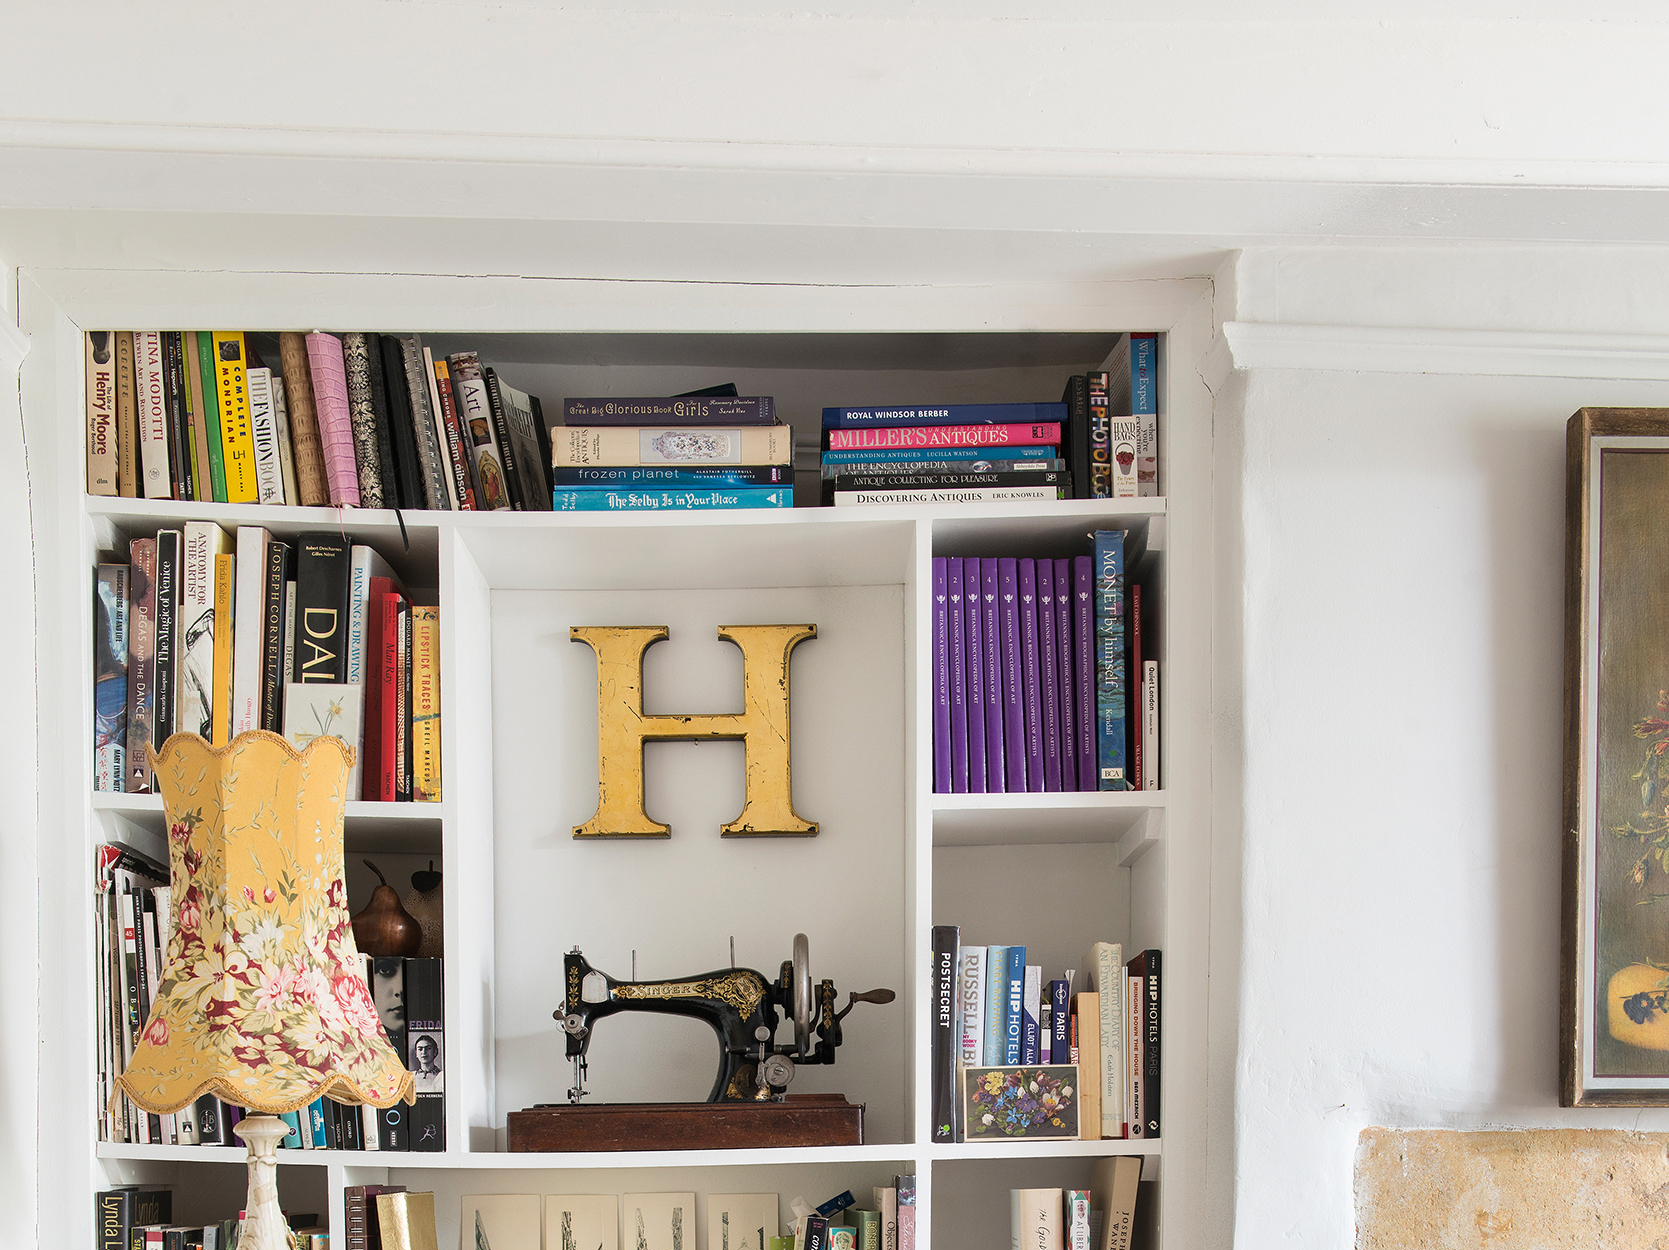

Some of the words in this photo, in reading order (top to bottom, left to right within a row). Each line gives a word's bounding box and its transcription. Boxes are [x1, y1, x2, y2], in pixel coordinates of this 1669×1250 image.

[146, 332, 159, 366] TINA
[1138, 341, 1149, 367] What
[1138, 367, 1147, 379] to
[92, 371, 110, 411] Henry
[233, 366, 247, 437] COMPLETE
[463, 384, 483, 414] Art
[1089, 372, 1109, 406] THE
[1137, 379, 1149, 411] Expect
[148, 370, 164, 441] MODOTTI
[222, 367, 236, 443] MONDRIAN
[569, 406, 590, 415] Great
[591, 406, 605, 417] Big
[605, 402, 653, 415] Glorious
[673, 401, 710, 417] Girls
[846, 411, 873, 420] ROYAL
[874, 410, 916, 419] WINDSOR
[917, 409, 949, 418] BERBER
[96, 414, 110, 455] Moore
[837, 427, 928, 448] MILLER'S
[928, 430, 1009, 446] ANTIQUES
[1091, 406, 1111, 462] PHOTO
[1113, 422, 1136, 433] HAND
[1114, 432, 1137, 441] BAGS
[578, 469, 627, 479] frozen
[632, 469, 680, 480] planet
[846, 461, 868, 470] THE
[869, 460, 948, 470] ENCYCLOPEDIA
[853, 476, 887, 487] ANTIQUE
[888, 474, 938, 485] COLLECTING
[941, 475, 959, 484] FOR
[960, 473, 999, 483] PLEASURE
[604, 492, 628, 509] The
[628, 493, 659, 509] Selby
[661, 493, 673, 507] Is
[675, 495, 686, 505] in
[685, 493, 711, 509] Your
[711, 493, 739, 506] Place
[856, 493, 927, 504] DISCOVERING
[929, 492, 983, 505] ANTIQUES
[1011, 491, 1045, 499] KNOWLES
[188, 537, 197, 560] THE
[197, 531, 207, 582] ANATOMY
[160, 560, 172, 592] Venice
[187, 561, 197, 599] ARTIST
[219, 559, 228, 579] Frida
[270, 545, 282, 600] JOSEPH
[1102, 549, 1117, 612] MONET
[159, 592, 172, 606] of
[198, 584, 207, 606] FOR
[218, 579, 228, 605] Kahlo
[353, 567, 364, 618] PAINTING
[137, 605, 149, 642] DEGAS
[158, 605, 173, 638] Magic
[1100, 617, 1115, 634] by
[136, 644, 146, 662] AND
[157, 638, 169, 665] The
[268, 605, 280, 671] CORNELL
[302, 606, 338, 684] DAL
[385, 642, 396, 664] Man
[420, 625, 431, 671] LIPSTICK
[350, 629, 362, 683] DRAWING
[1103, 637, 1119, 689] himself
[135, 663, 146, 680] THE
[382, 666, 395, 685] Ray
[135, 682, 147, 720] DANCE
[421, 674, 432, 712] TRACES
[1104, 768, 1120, 778] BCA
[125, 930, 134, 938] 45
[993, 951, 1003, 985] CLARE
[637, 984, 692, 998] SINGER
[939, 952, 951, 1029] POSTSECRET
[963, 954, 980, 1035] RUSSELL
[1010, 980, 1022, 1013] HIP
[1149, 975, 1158, 1002] HIP
[408, 1019, 443, 1028] FRIDA
[991, 988, 1001, 1036] BALDING
[1056, 1011, 1066, 1041] PARIS
[1149, 1003, 1158, 1043] HOTELS
[1007, 1015, 1020, 1065] HOTELS
[1148, 1046, 1158, 1077] PARIS
[102, 1196, 124, 1237] Lynda
[1038, 1208, 1047, 1222] The
[1076, 1221, 1084, 1231] AT
